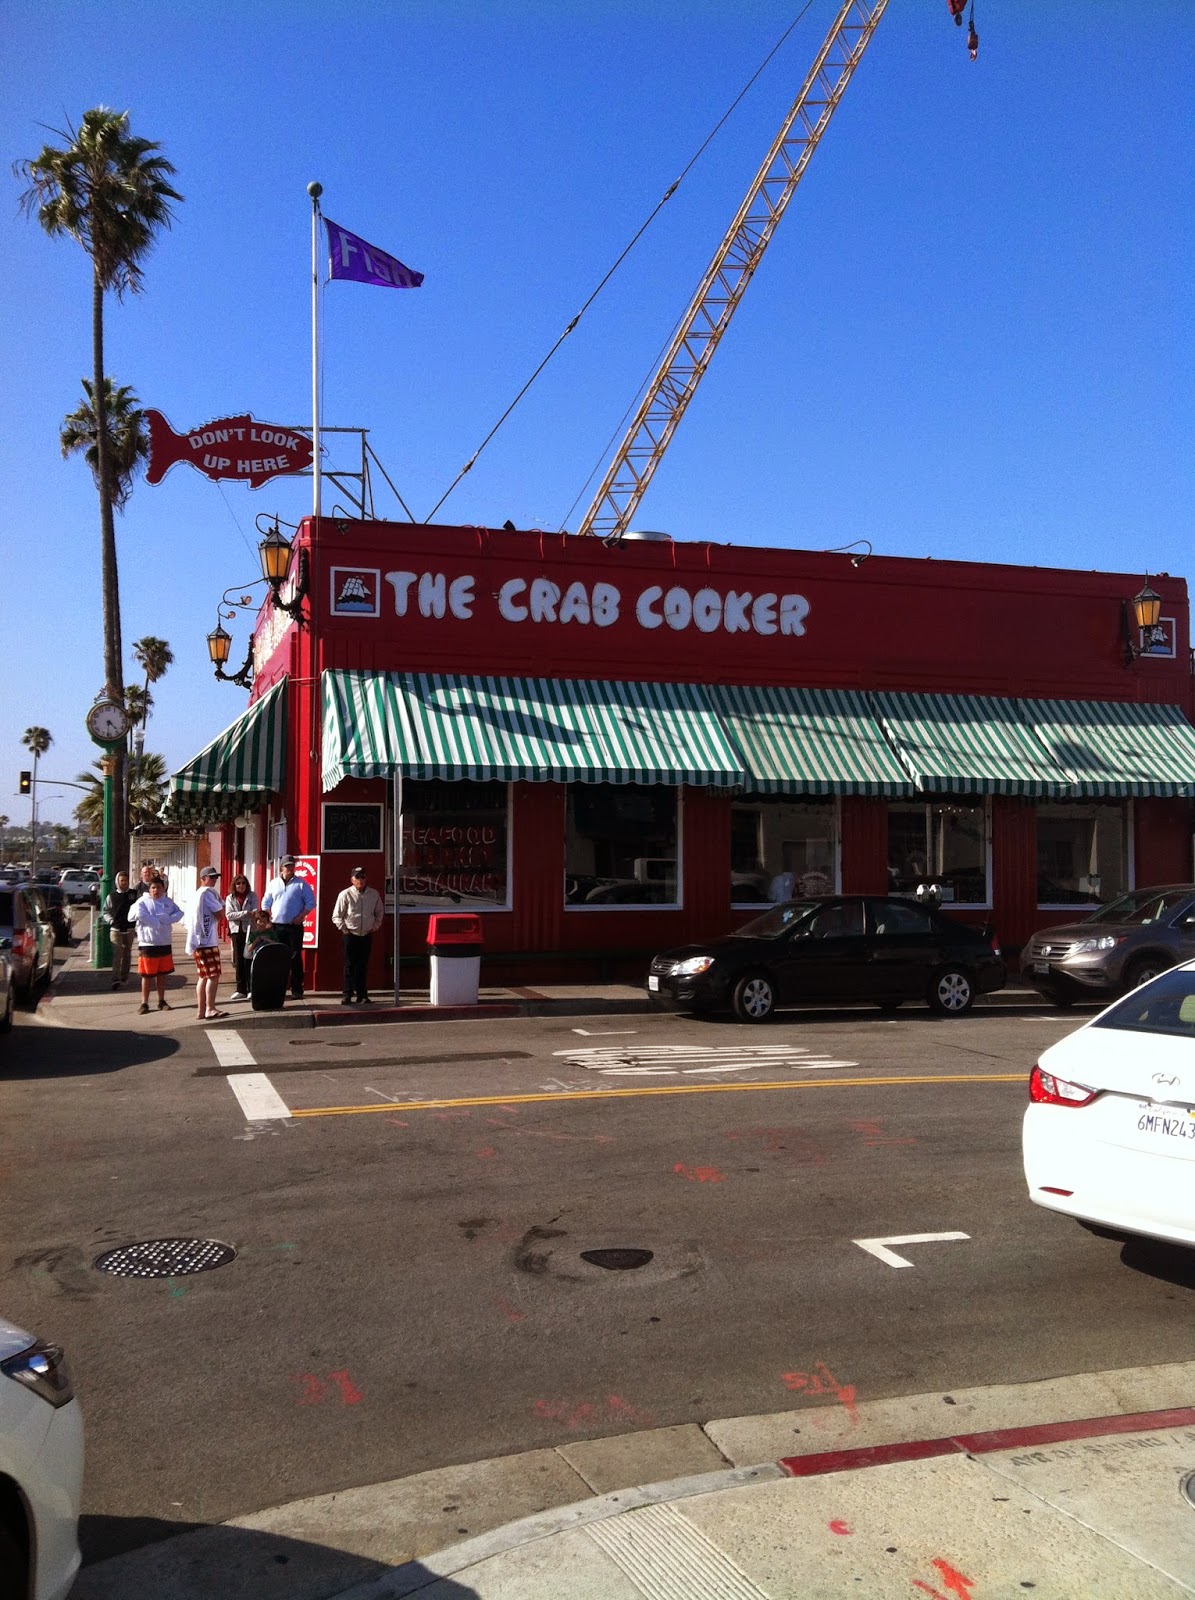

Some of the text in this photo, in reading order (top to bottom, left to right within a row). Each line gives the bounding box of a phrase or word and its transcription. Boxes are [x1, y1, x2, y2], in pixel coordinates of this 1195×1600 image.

[188, 428, 301, 451] DON'T LOOK
[202, 454, 290, 473] UP HERE
[385, 571, 810, 637] THE CRAB COOKER
[1137, 1114, 1195, 1140] 6MFN243
